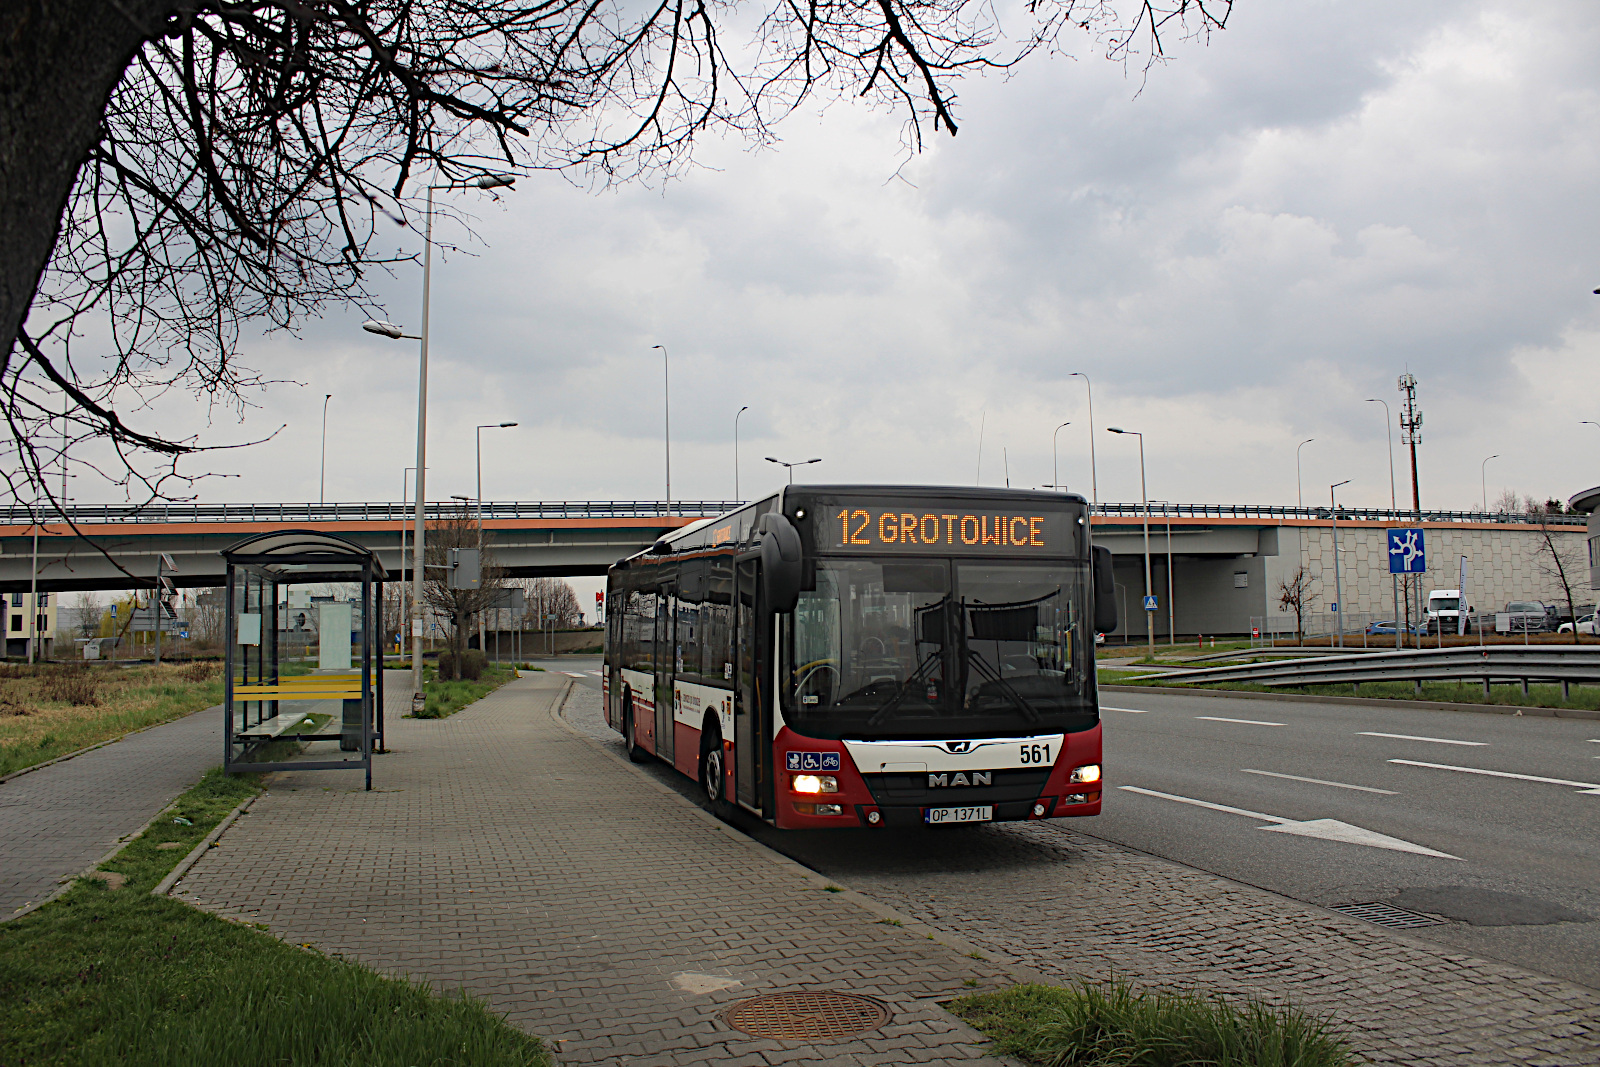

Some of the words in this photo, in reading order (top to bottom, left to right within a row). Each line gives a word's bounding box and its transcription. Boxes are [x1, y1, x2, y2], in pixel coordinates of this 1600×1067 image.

[836, 509, 870, 544] 12
[878, 512, 1045, 546] GROTOWICE
[1020, 743, 1051, 764] 561
[928, 771, 992, 787] MAN
[932, 809, 949, 821] OP
[954, 807, 989, 820] 1371L
